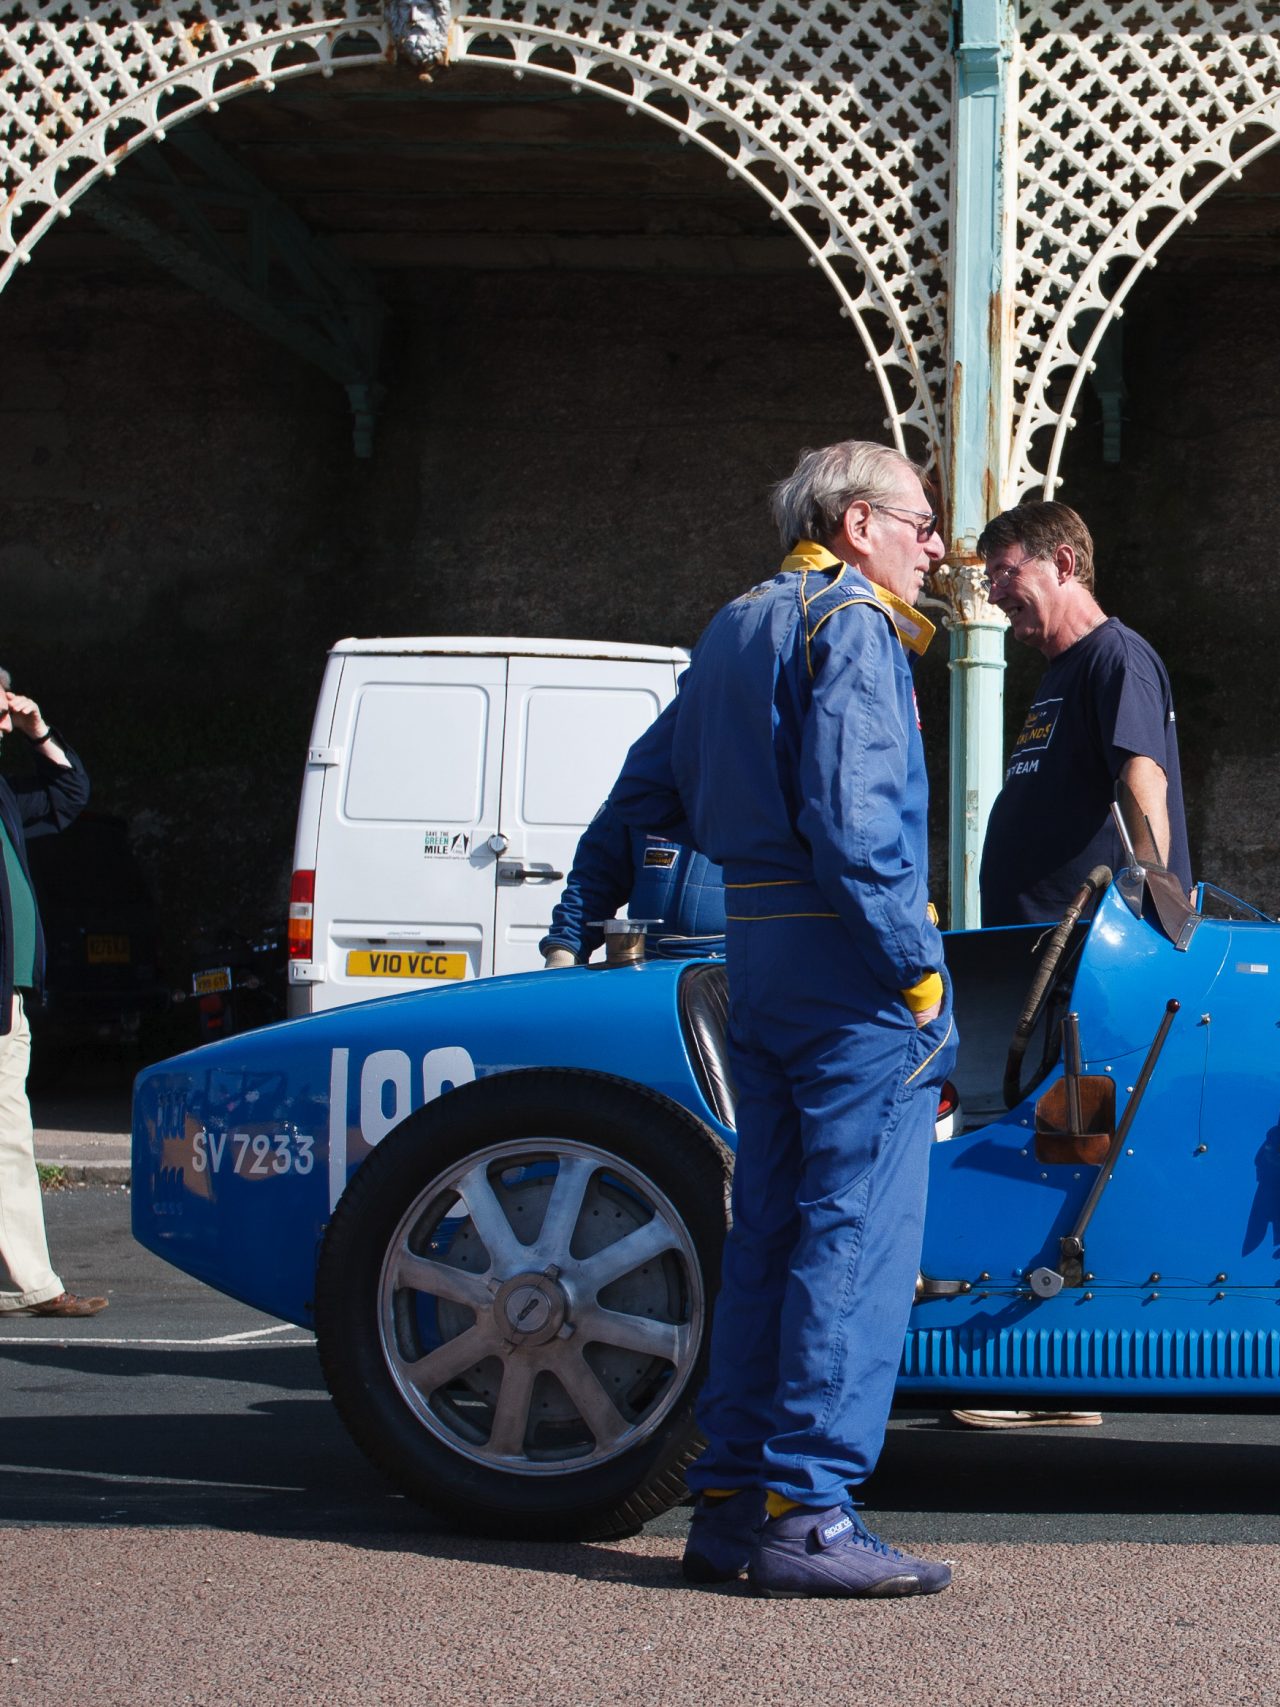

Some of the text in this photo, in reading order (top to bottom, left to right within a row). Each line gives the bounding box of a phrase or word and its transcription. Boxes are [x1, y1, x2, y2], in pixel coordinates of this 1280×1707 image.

[424, 836, 449, 845] GREEN
[424, 845, 449, 854] MILE
[369, 953, 448, 974] V10 VCC
[192, 1132, 315, 1175] SV 7233
